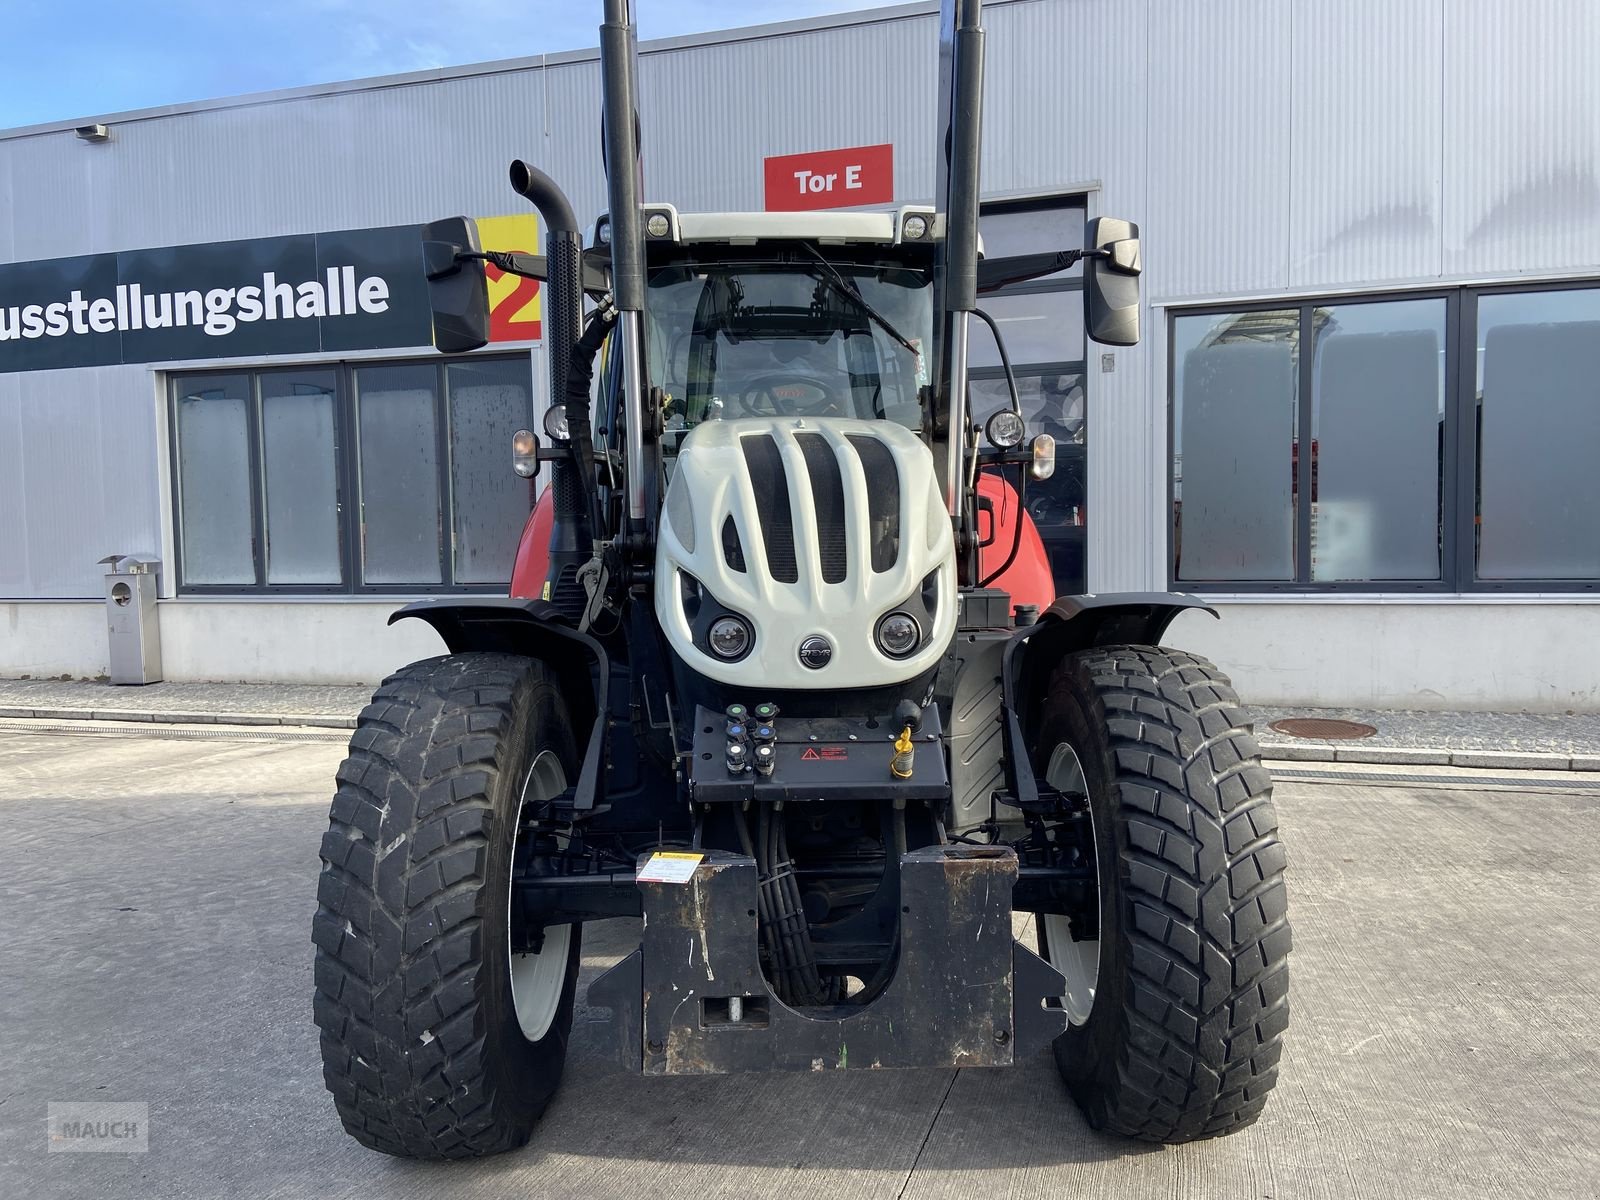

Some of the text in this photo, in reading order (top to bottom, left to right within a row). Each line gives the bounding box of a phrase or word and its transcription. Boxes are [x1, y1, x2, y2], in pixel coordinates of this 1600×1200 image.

[794, 165, 862, 193] Tor E
[0, 251, 542, 342] usstellungshalle 2
